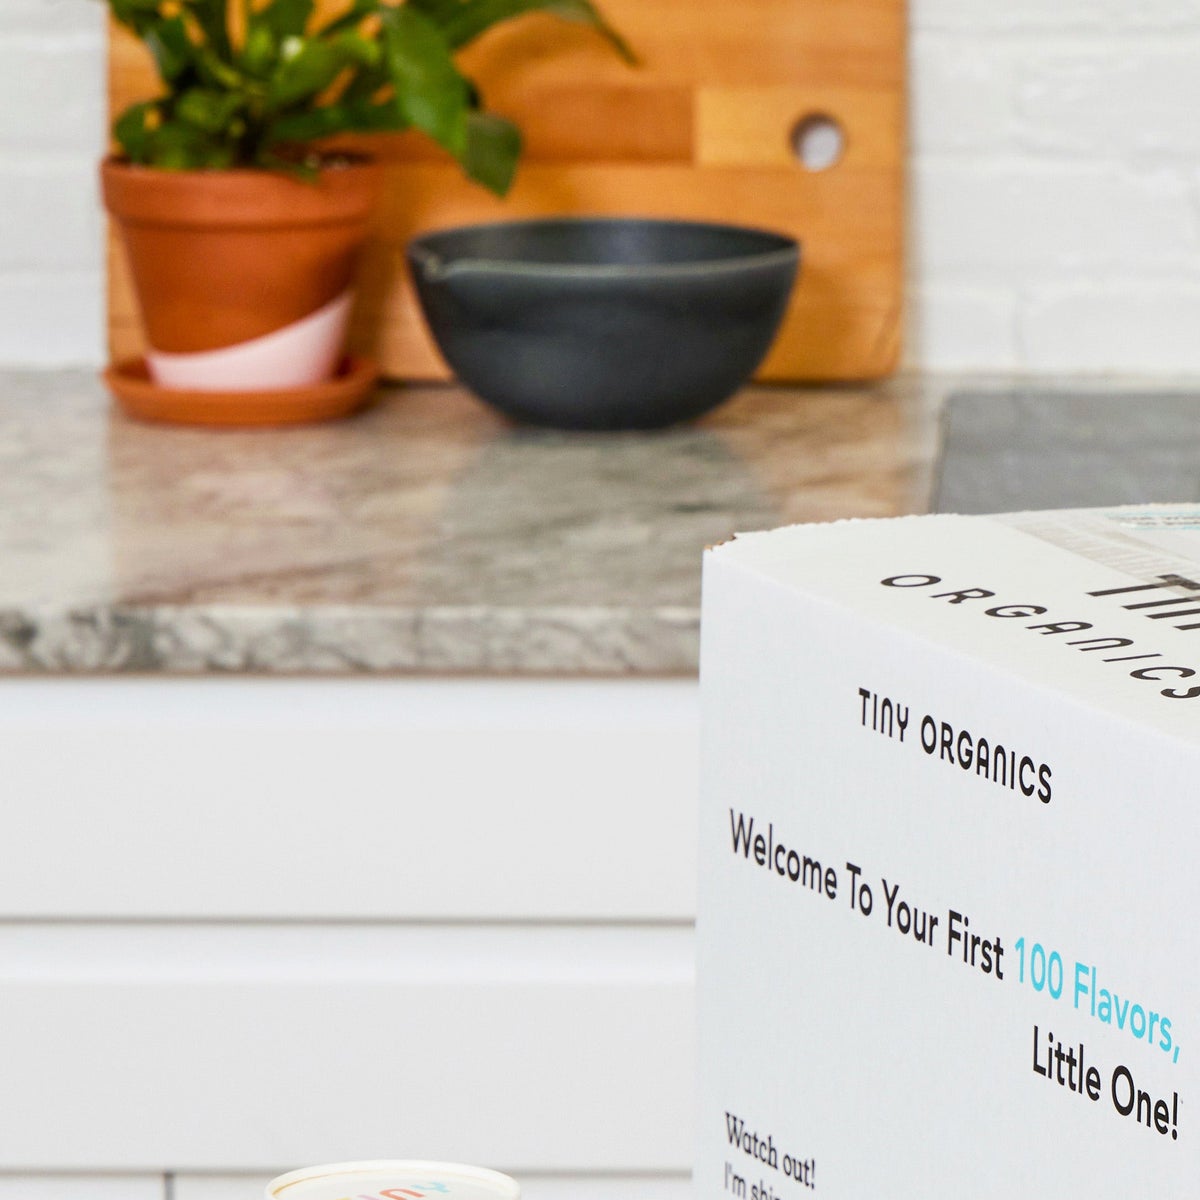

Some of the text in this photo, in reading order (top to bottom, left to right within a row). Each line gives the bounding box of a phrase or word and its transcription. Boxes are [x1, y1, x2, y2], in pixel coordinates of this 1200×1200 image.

[859, 688, 1053, 803] TINY ORGANICS
[730, 808, 1180, 1064] Welcome To Your First 100 Flavors,
[1033, 1025, 1178, 1141] Little One!
[724, 1161, 746, 1200] I'm
[725, 1111, 815, 1189] Watch out!
